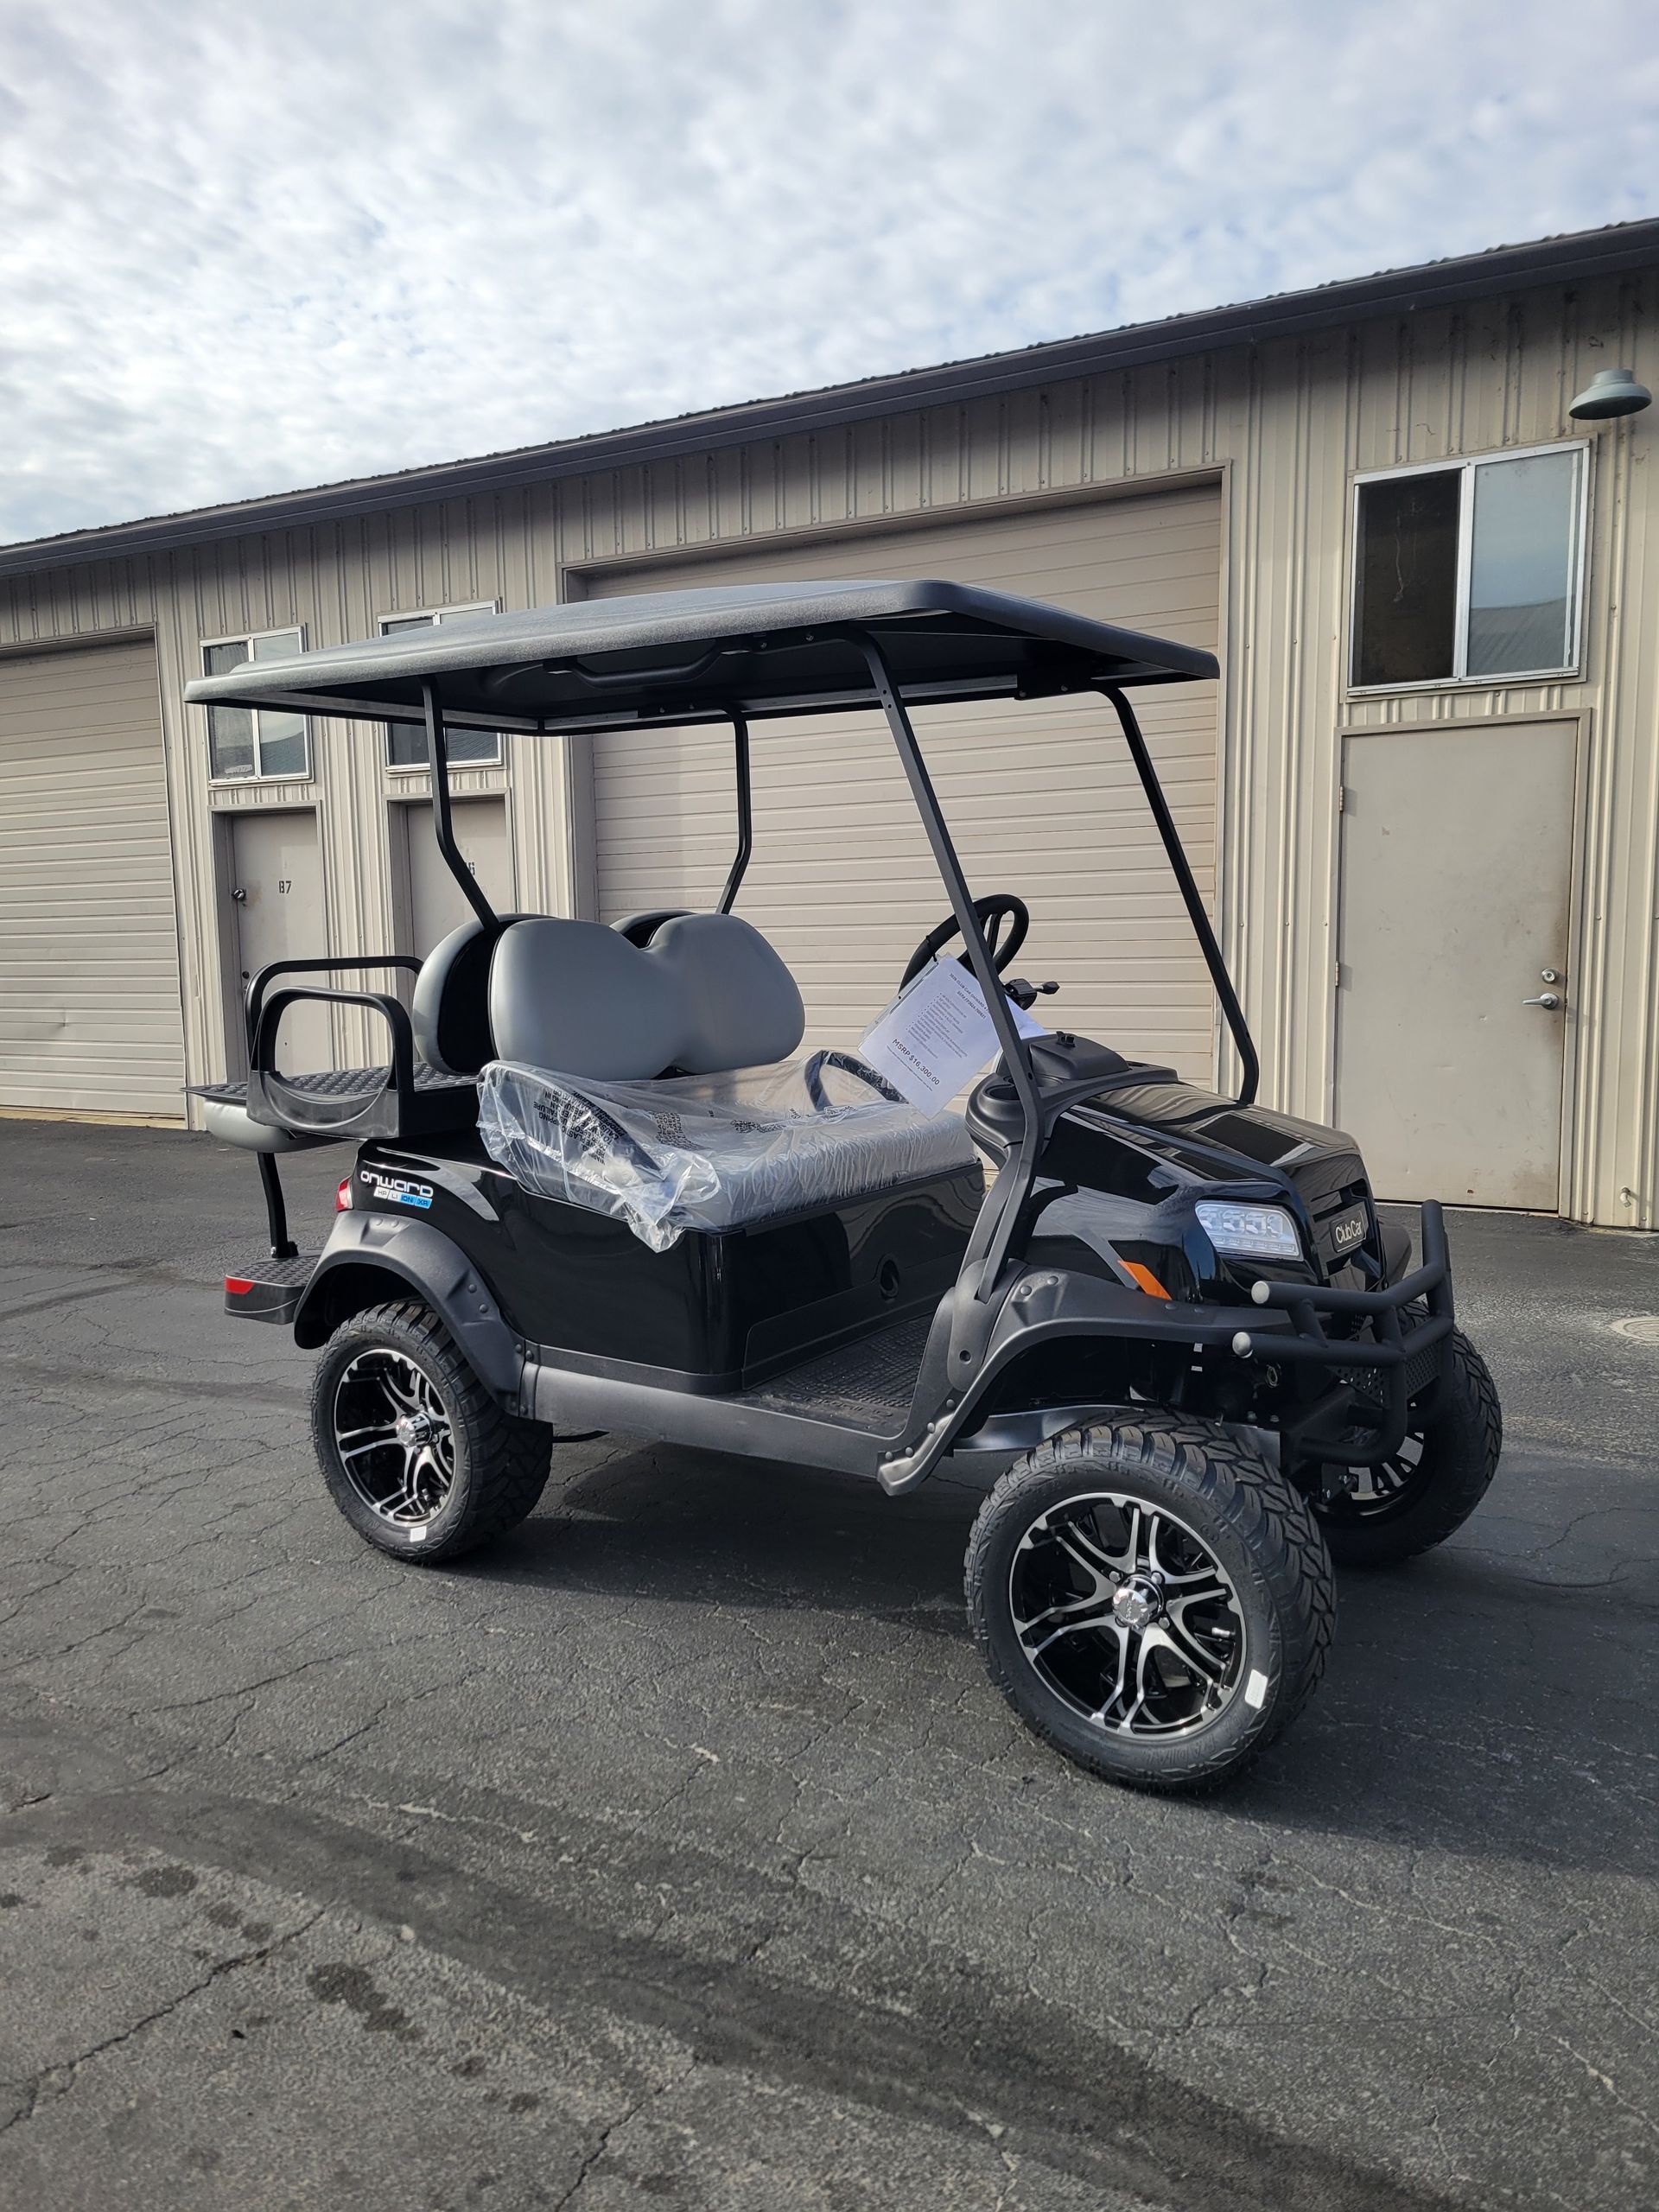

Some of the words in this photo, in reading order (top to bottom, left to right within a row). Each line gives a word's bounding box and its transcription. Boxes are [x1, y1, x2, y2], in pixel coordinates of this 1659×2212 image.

[892, 1038, 911, 1057] MSRP
[907, 1053, 940, 1086] $16,300.00
[533, 1101, 558, 1116] FAILURE
[552, 1095, 583, 1116] RESULTING
[598, 1121, 619, 1141] CAUSE
